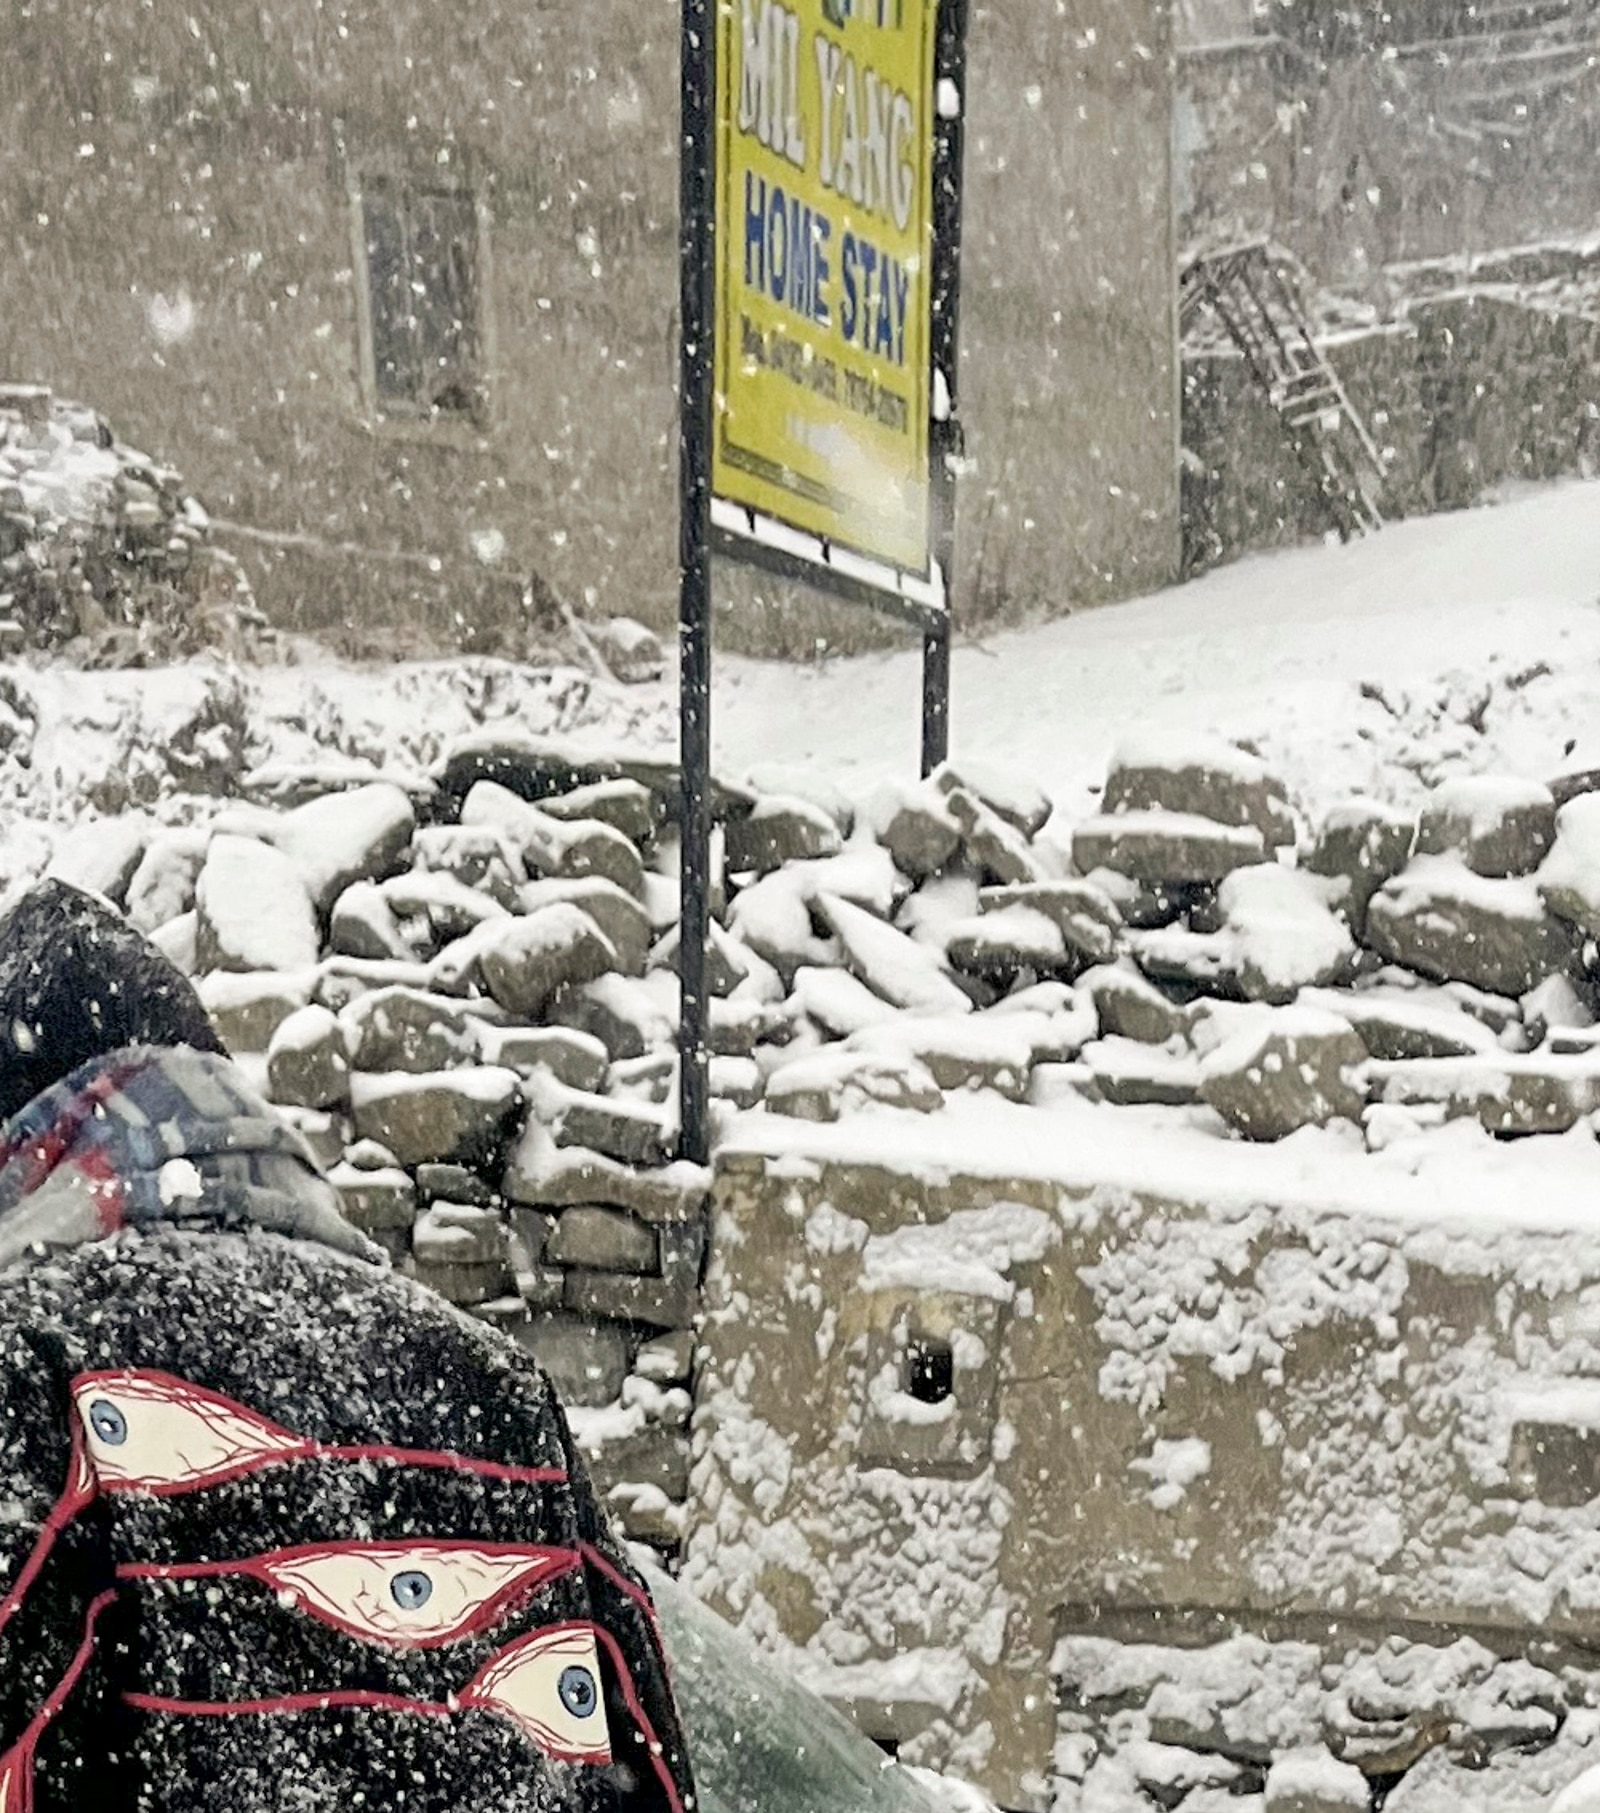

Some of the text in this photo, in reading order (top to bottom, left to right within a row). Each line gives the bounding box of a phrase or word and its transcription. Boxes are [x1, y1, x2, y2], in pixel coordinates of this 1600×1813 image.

[738, 0, 914, 232] MIL YANG
[743, 169, 912, 367] HOME STAY
